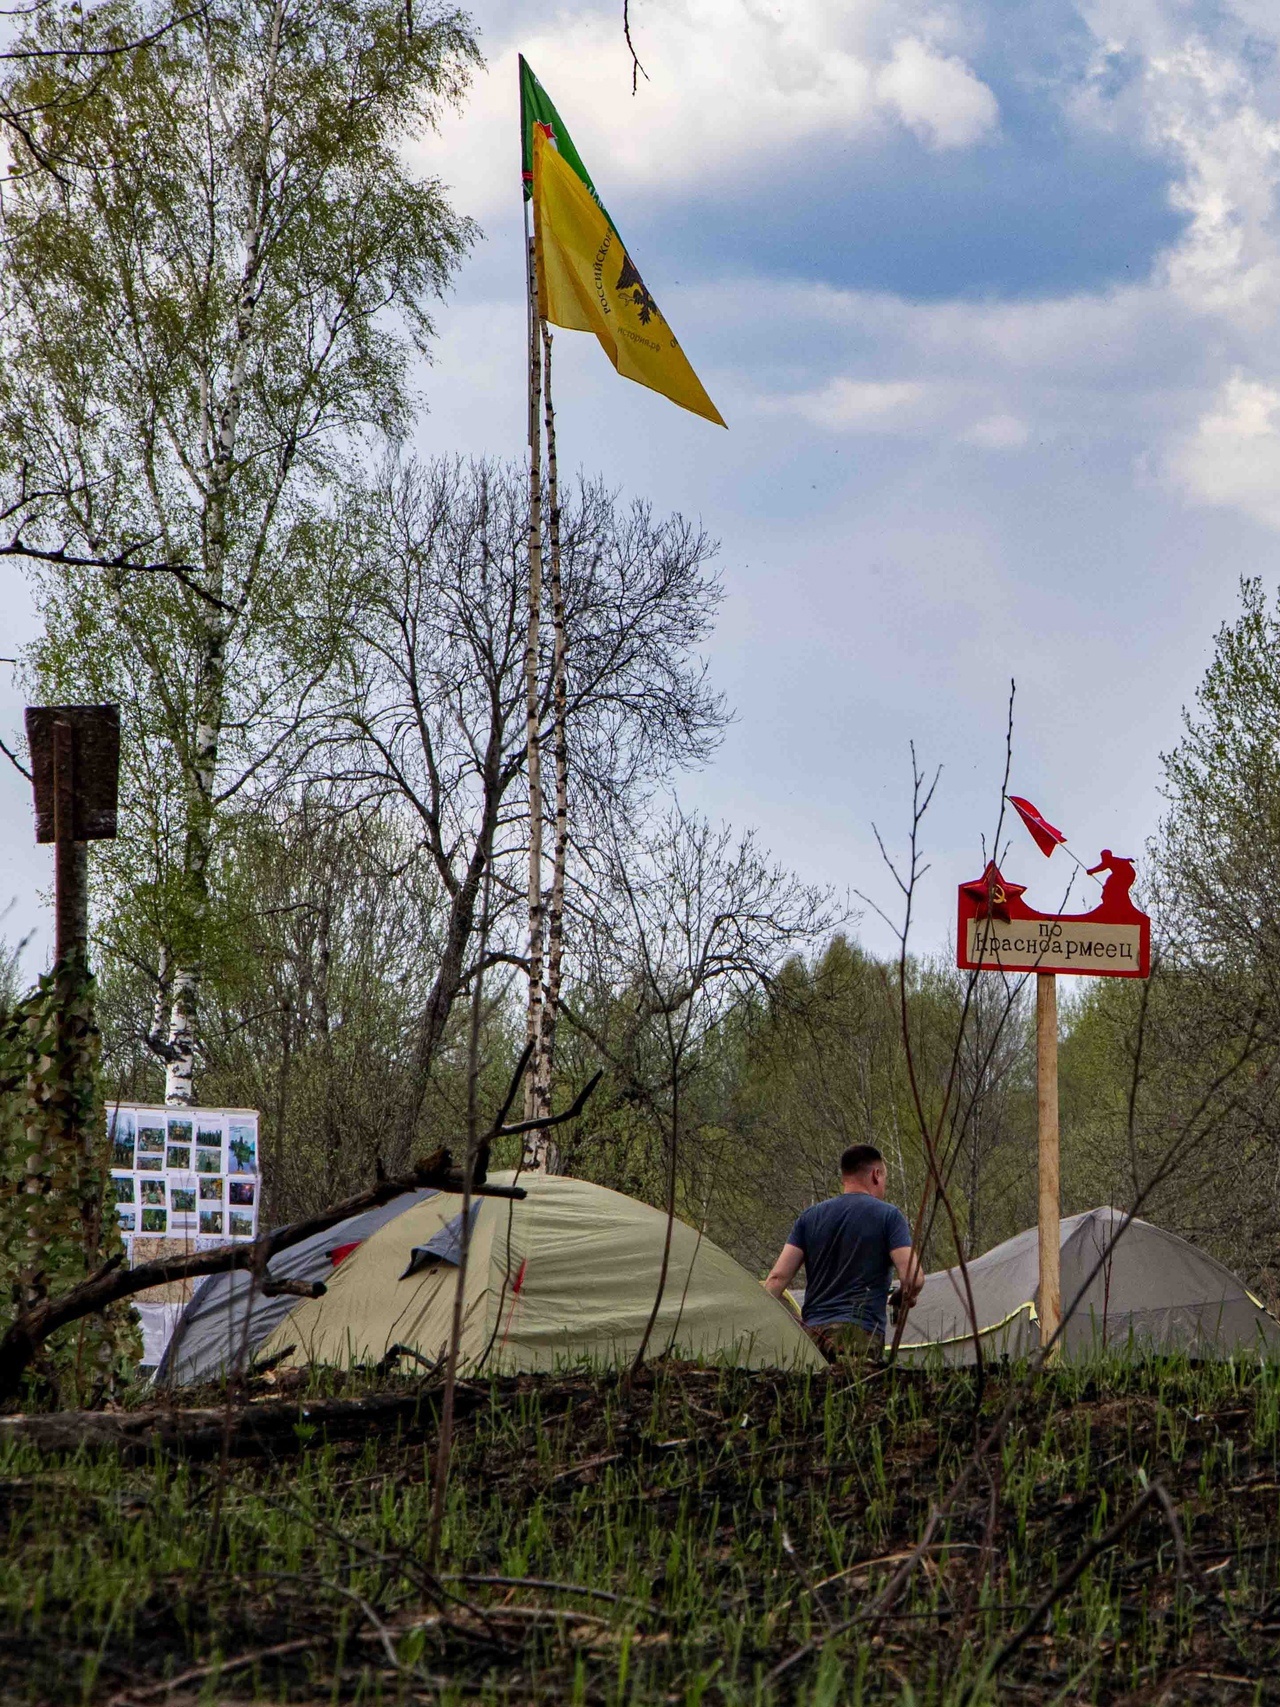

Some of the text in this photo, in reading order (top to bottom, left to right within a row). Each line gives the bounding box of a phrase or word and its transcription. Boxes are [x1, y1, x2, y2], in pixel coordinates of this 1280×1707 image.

[617, 326, 661, 353] история.рф
[1039, 923, 1063, 937] по
[975, 932, 1133, 960] Красноармеец
